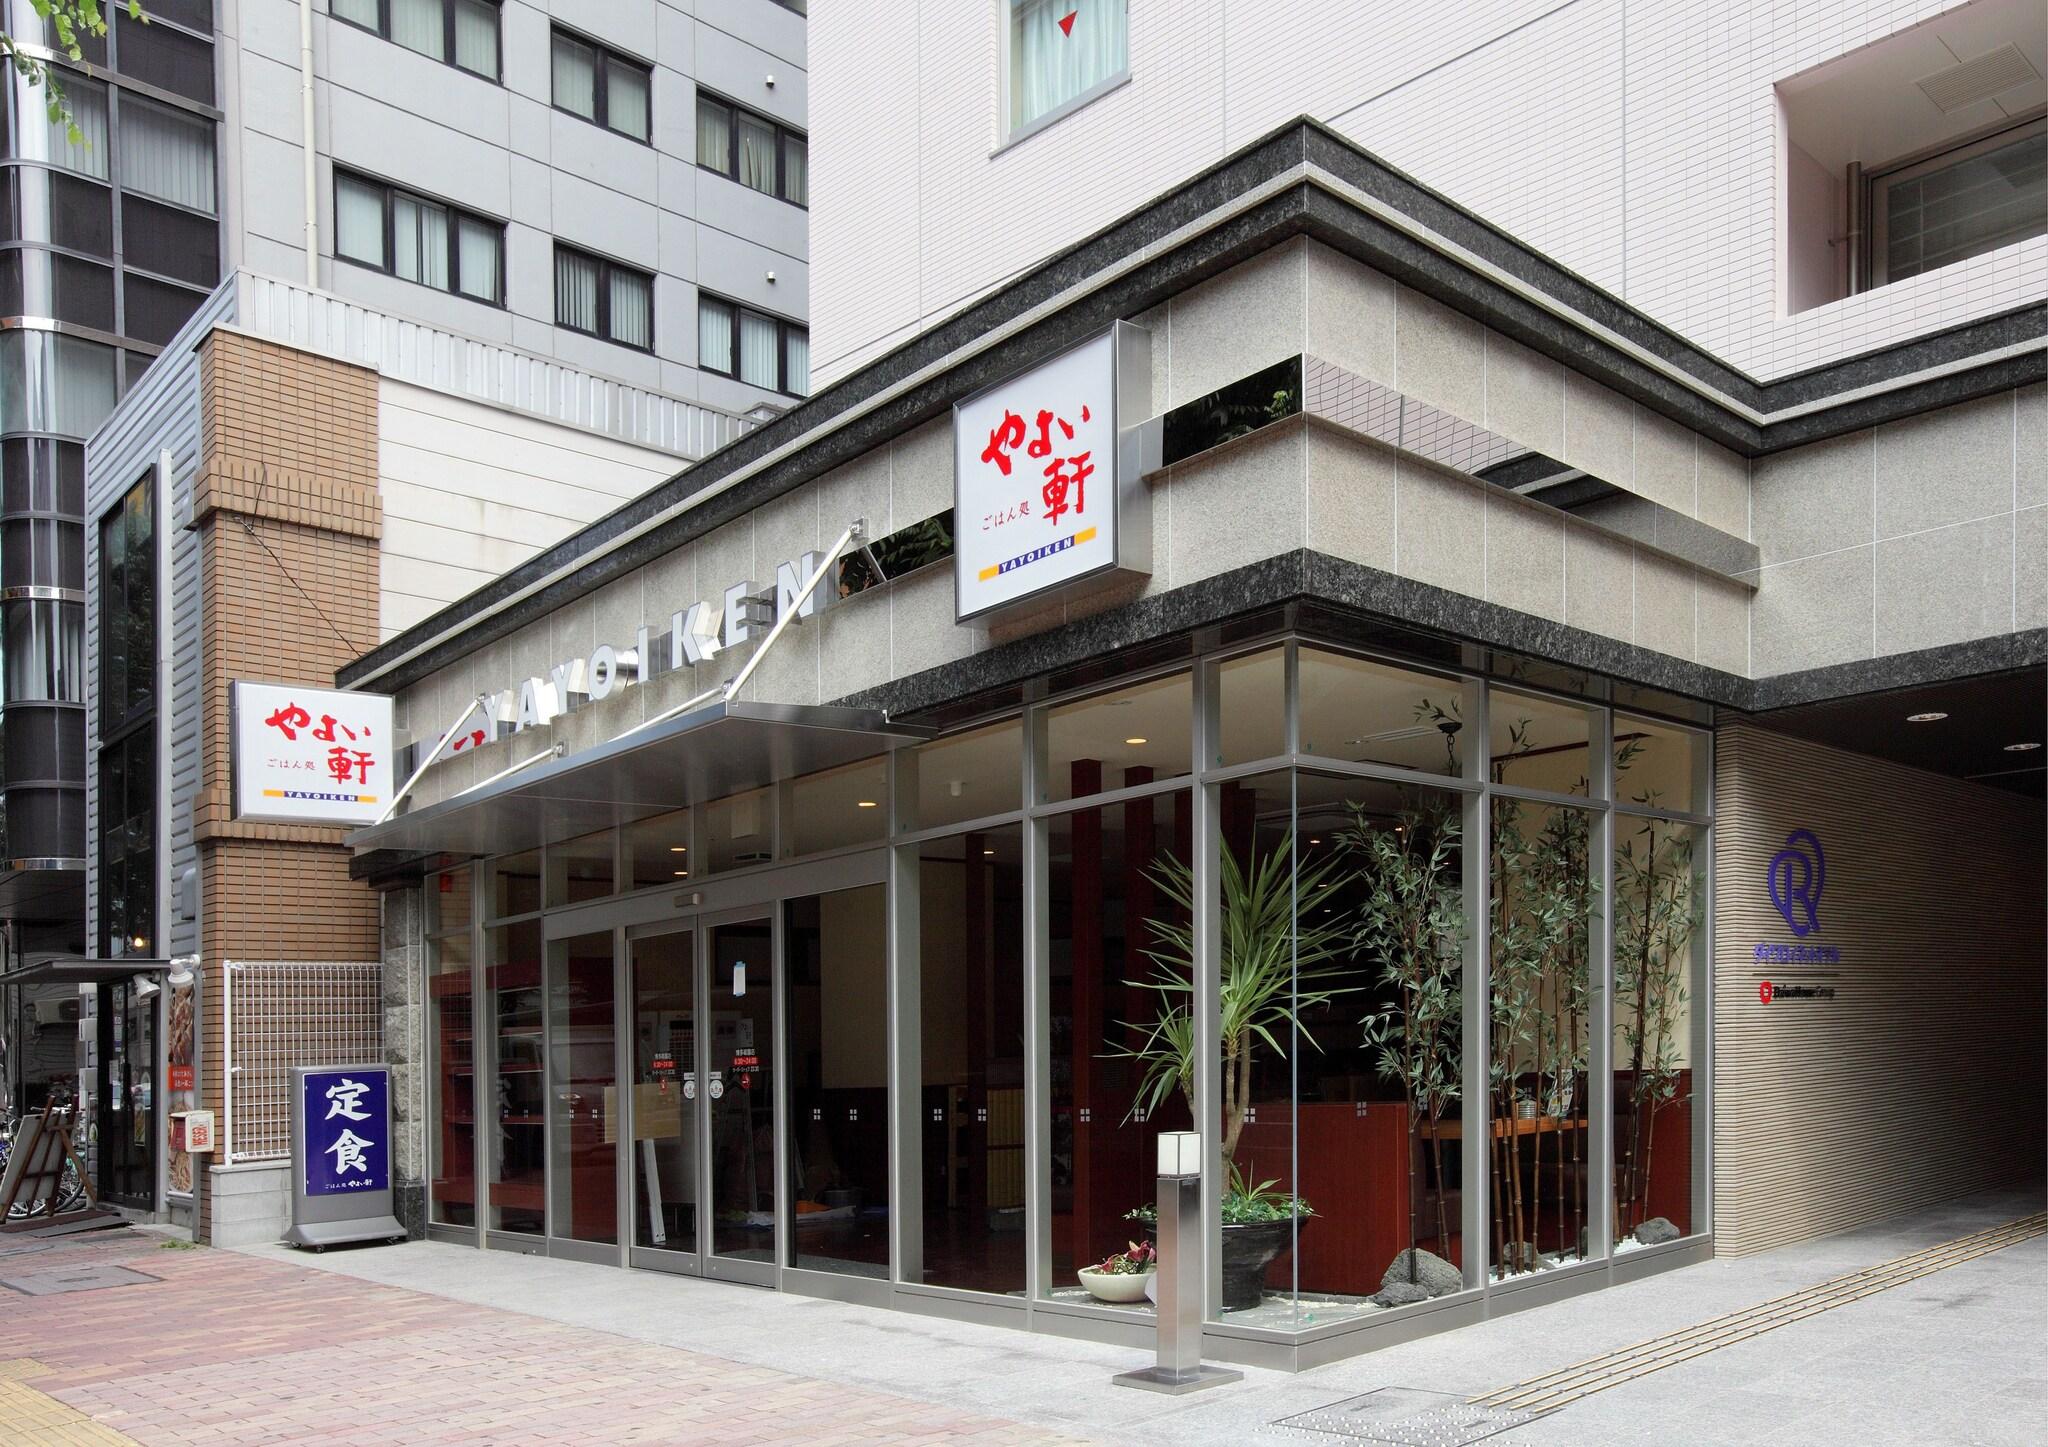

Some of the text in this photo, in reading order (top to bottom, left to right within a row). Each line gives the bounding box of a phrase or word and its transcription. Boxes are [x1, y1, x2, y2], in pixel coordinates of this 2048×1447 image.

[980, 404, 1092, 477] やよい
[1041, 450, 1095, 527] 軒
[980, 499, 1031, 532] ごはん処
[1000, 536, 1074, 573] YAYOIKEN
[484, 551, 824, 743] YAYOIKEN
[264, 701, 372, 743] やよい
[266, 758, 317, 771] ごはん処
[327, 746, 376, 785] 軒
[286, 790, 358, 803] YAYOIKEN
[324, 1077, 375, 1175] 定食
